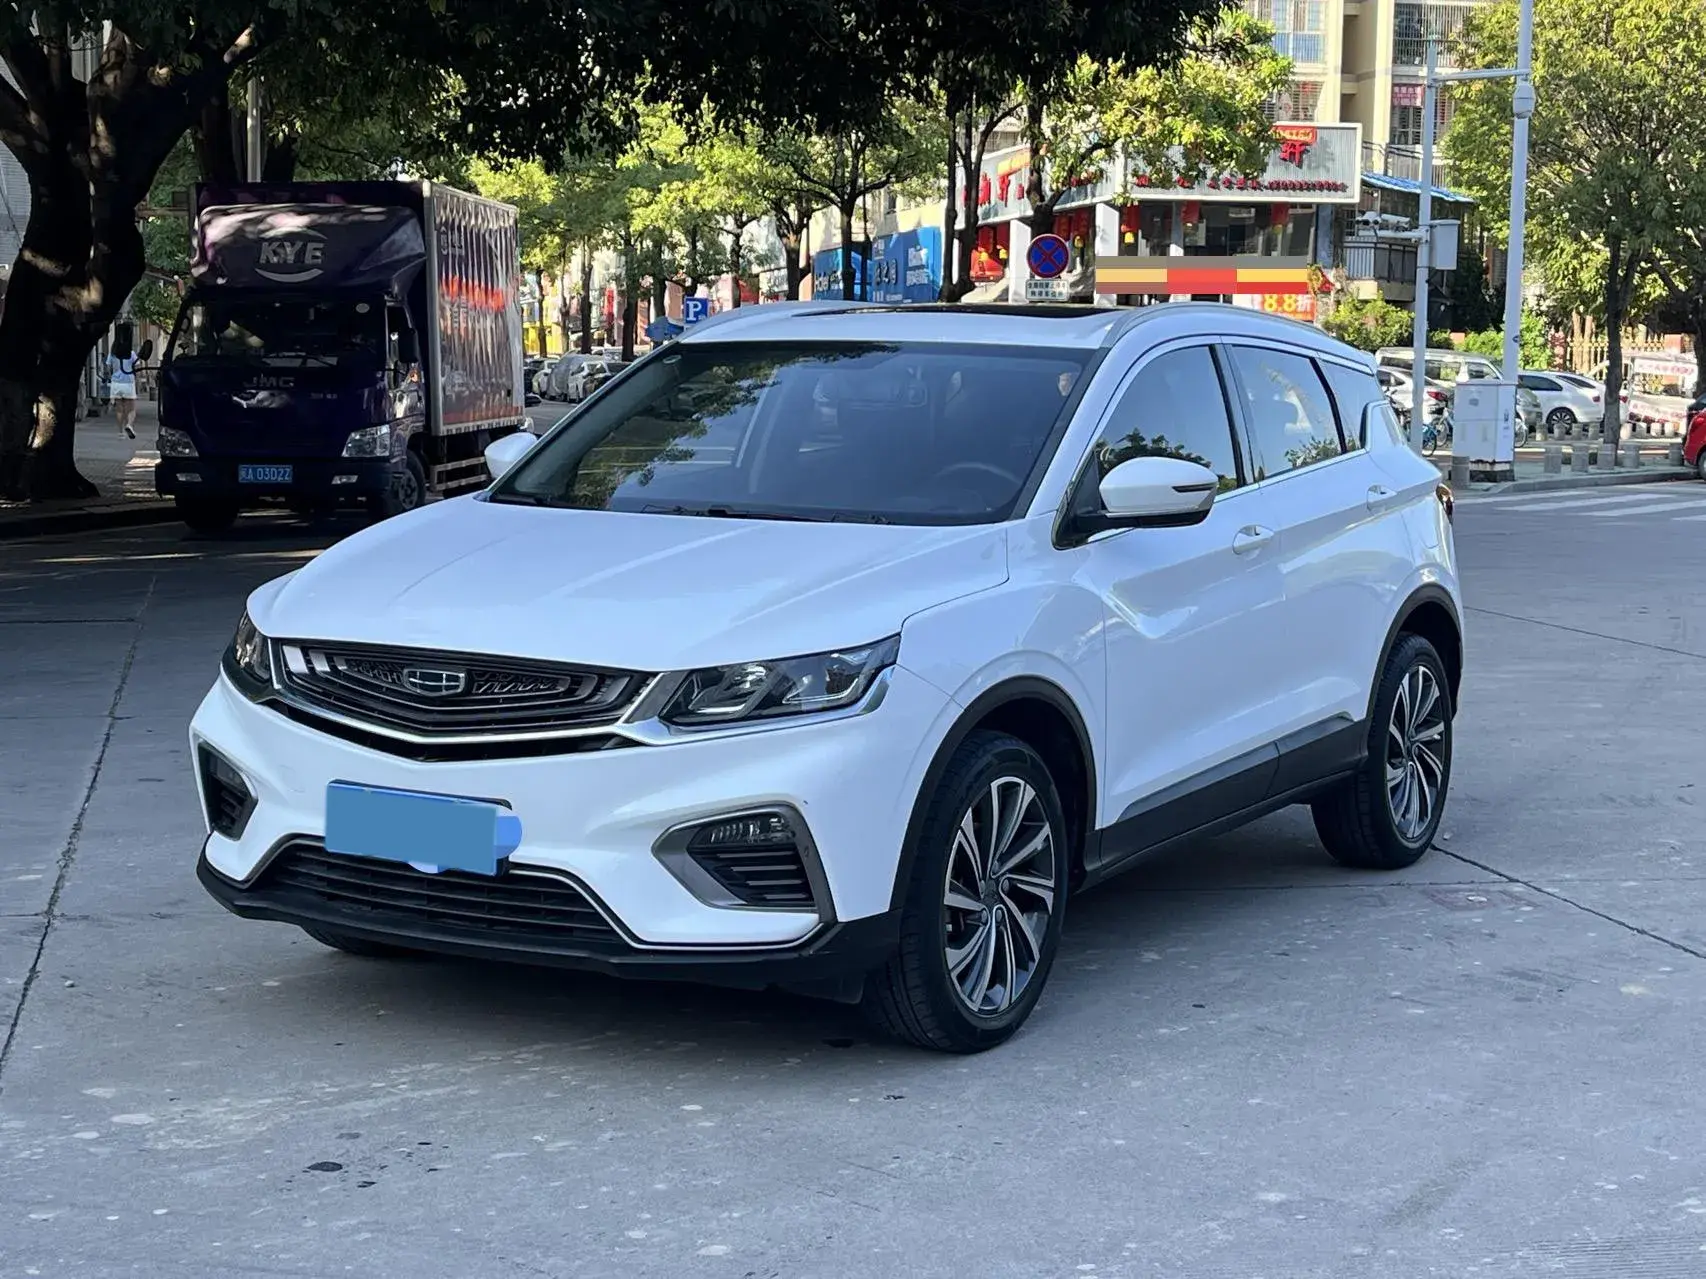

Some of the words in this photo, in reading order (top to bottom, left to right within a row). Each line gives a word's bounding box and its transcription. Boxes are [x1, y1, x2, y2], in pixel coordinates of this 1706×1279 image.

[259, 241, 325, 264] KYE
[686, 300, 702, 321] P
[243, 375, 295, 388] JMC
